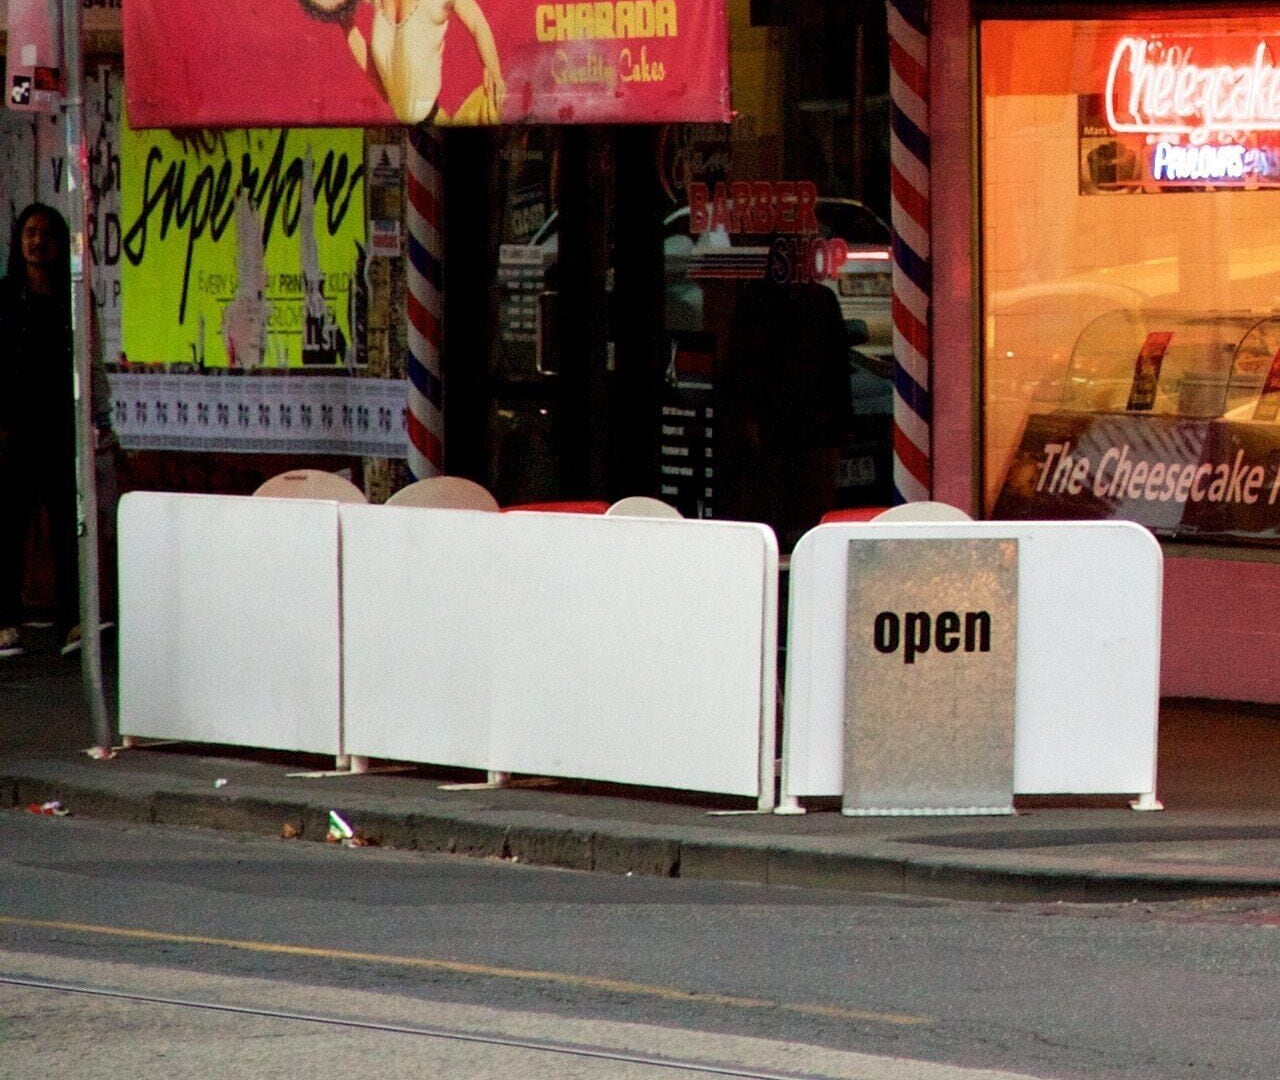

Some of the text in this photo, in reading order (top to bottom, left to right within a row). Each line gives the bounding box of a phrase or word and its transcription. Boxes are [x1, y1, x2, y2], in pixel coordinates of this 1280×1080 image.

[536, 0, 677, 42] CHARADA
[620, 45, 666, 83] Cakes
[689, 180, 820, 234] BARBER
[770, 237, 848, 283] SHOP
[1035, 441, 1088, 496] The
[1094, 445, 1265, 505] Cheesecake
[873, 610, 992, 664] open
